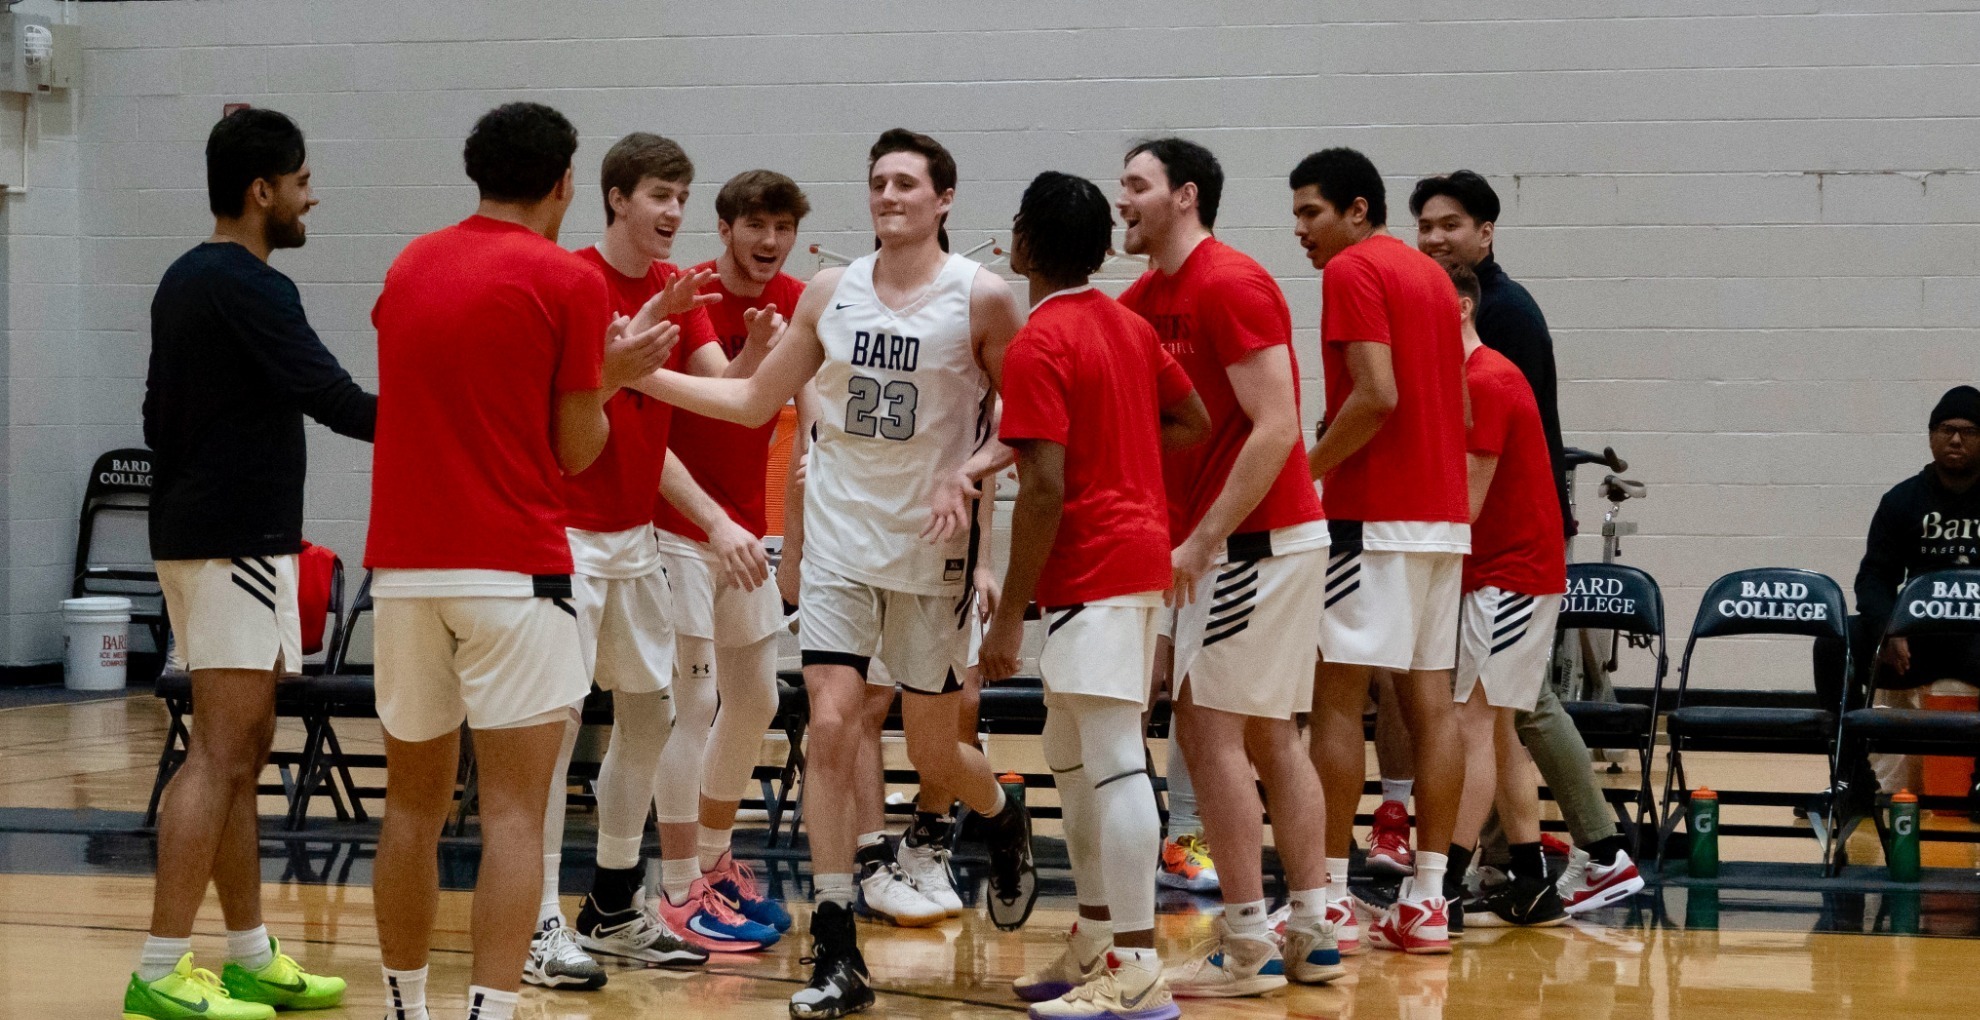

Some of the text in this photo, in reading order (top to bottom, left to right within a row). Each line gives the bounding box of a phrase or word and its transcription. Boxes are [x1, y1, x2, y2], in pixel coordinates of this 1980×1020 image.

[851, 330, 920, 372] BARD
[845, 375, 918, 441] 23
[112, 459, 151, 473] BARD
[99, 472, 153, 487] COLLEG
[1921, 511, 1980, 540] Bar
[1921, 545, 1977, 554] BASEBA
[1740, 581, 1809, 600] BARD
[1931, 581, 1980, 599] BAR
[1559, 596, 1635, 615] OLLEGE
[1718, 599, 1828, 621] COLLEGE
[1695, 813, 1711, 833] G
[1895, 815, 1911, 835] G
